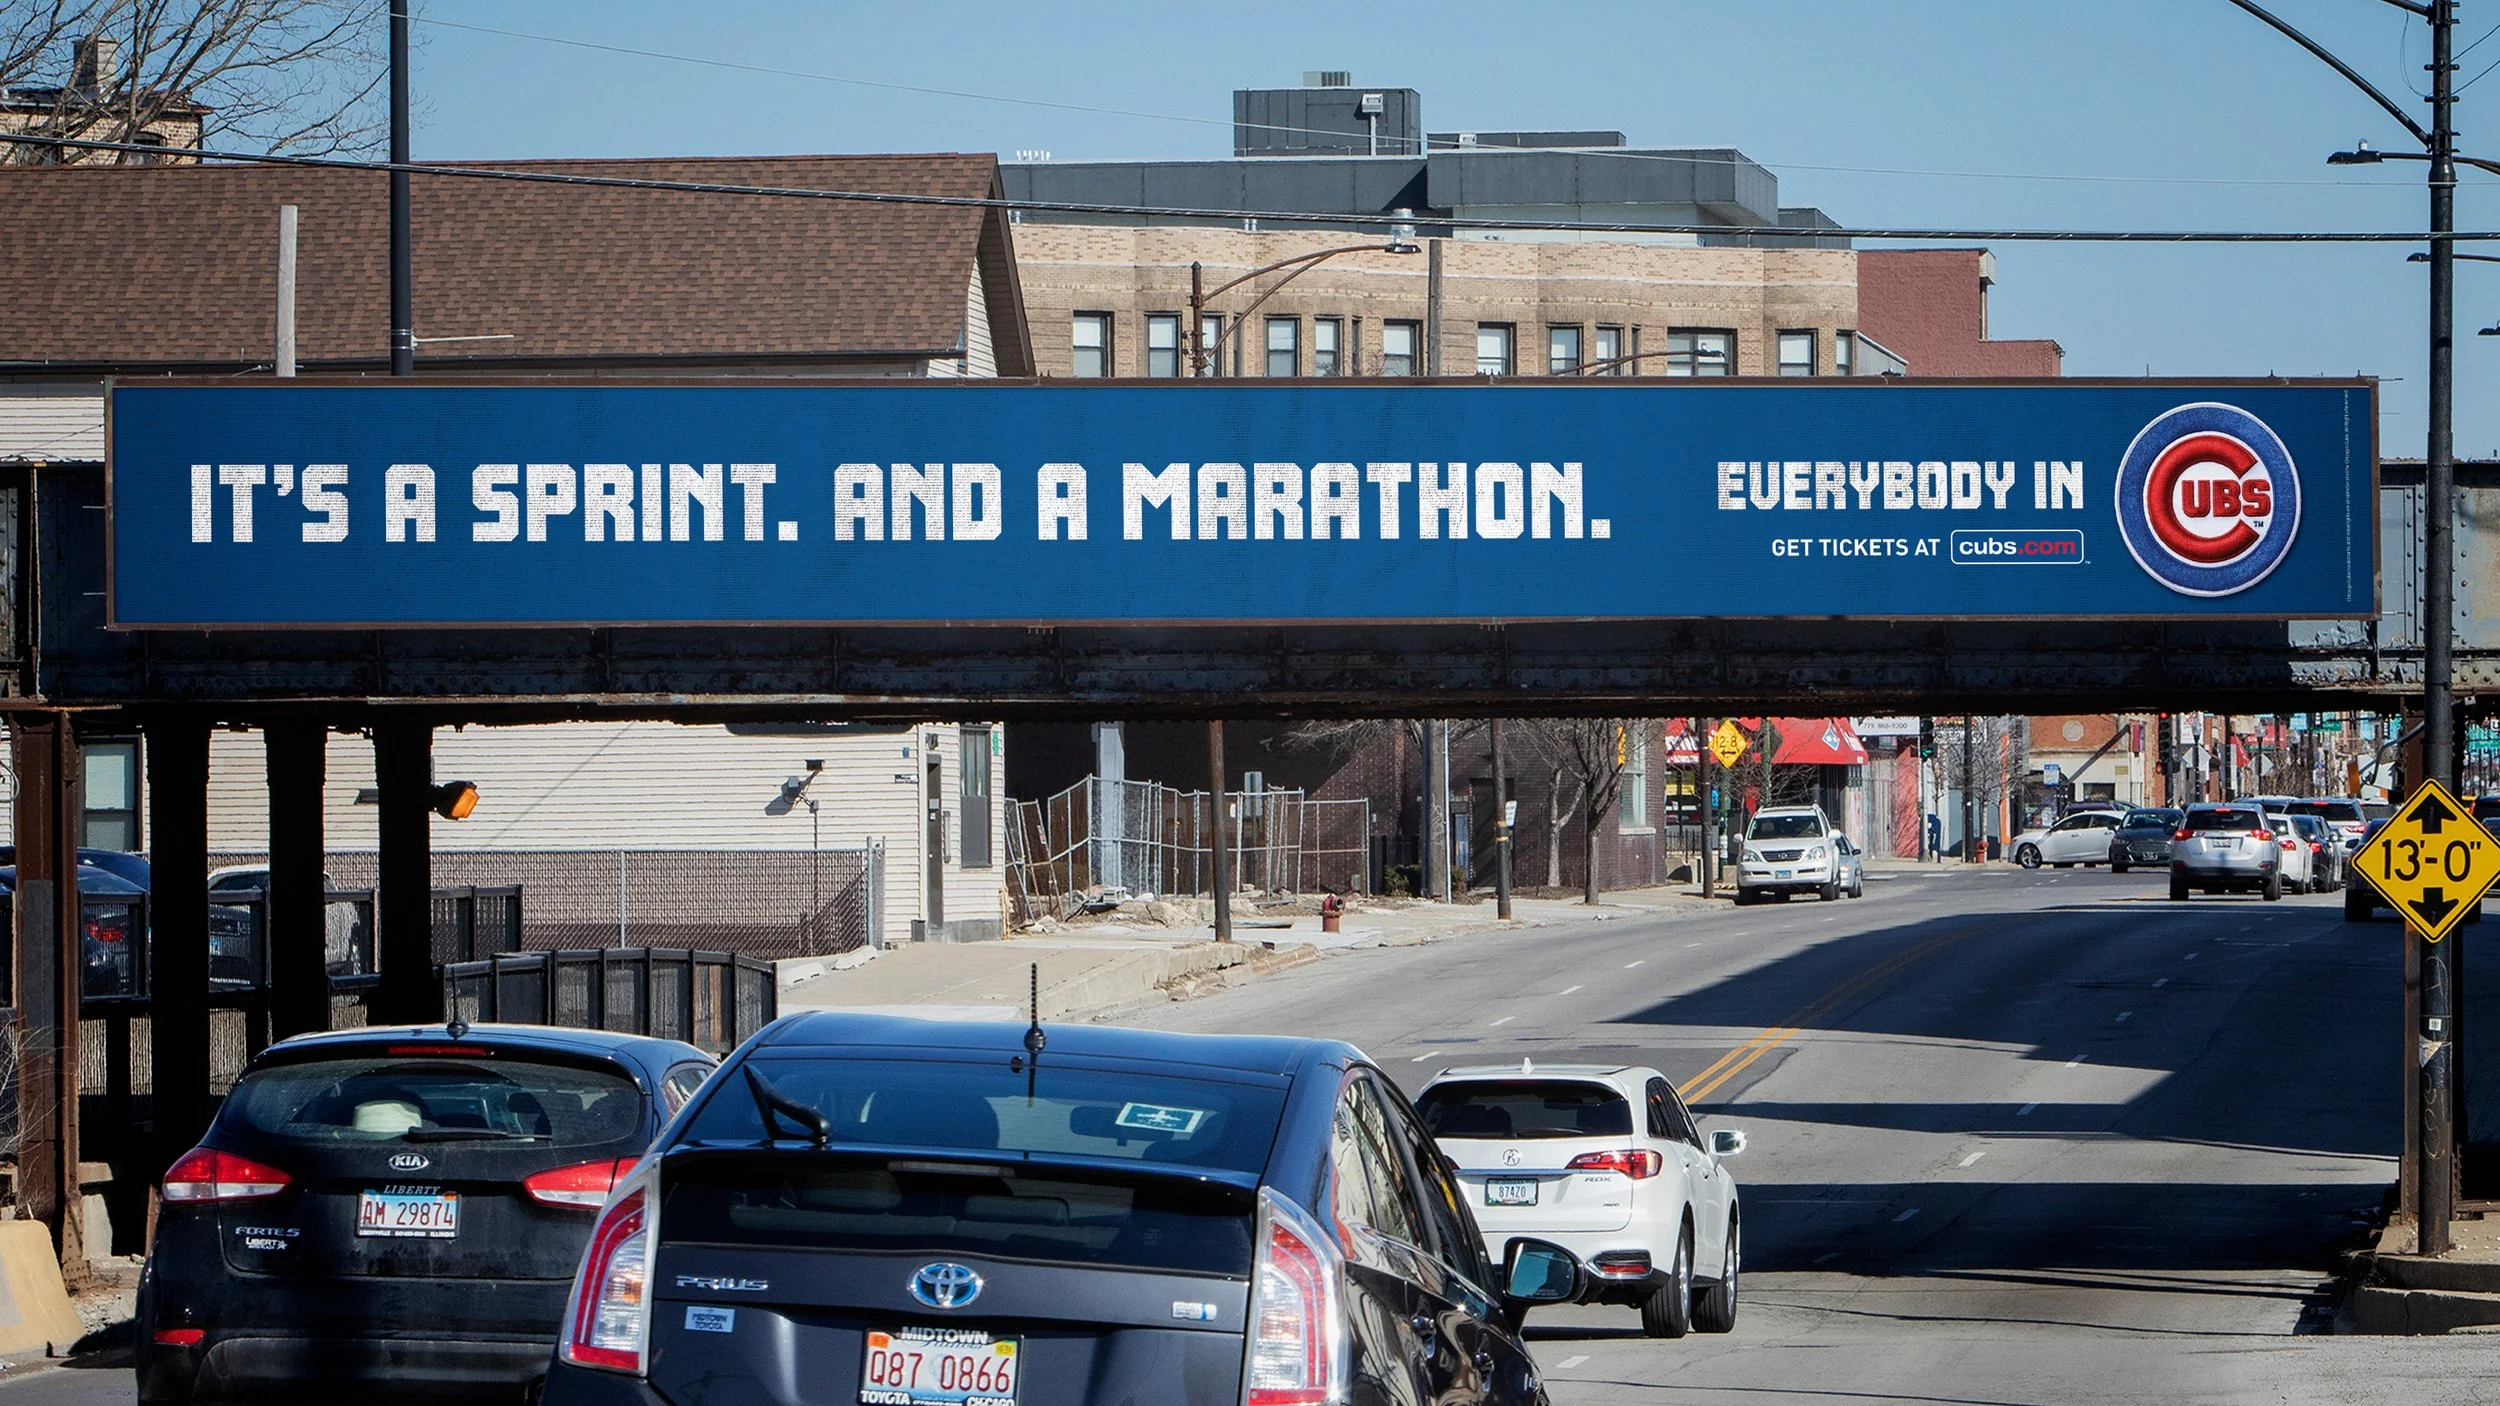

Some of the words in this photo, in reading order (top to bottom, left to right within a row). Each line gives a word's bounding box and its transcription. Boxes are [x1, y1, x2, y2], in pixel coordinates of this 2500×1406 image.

[1718, 461, 2015, 510] EVERYBODY
[2035, 461, 2084, 509] IN
[192, 464, 348, 542] IT'S
[386, 465, 436, 542] A
[472, 464, 798, 542] SPRINT.
[834, 463, 1002, 541] AND
[1037, 463, 1088, 541] A
[1122, 462, 1611, 540] MARATHON.
[1772, 539, 1813, 557] GET
[1818, 538, 1909, 557] TICKETS
[1915, 538, 1941, 556] AT
[1959, 537, 2076, 555] cubs.com
[394, 1155, 422, 1167] KIA
[383, 1184, 441, 1195] LIBERTY
[362, 1200, 386, 1225] AM
[396, 1201, 453, 1226] 29874
[676, 1275, 769, 1292] PRIUS
[900, 1326, 989, 1345] MIDTOWN
[870, 1350, 923, 1389] Q87
[940, 1355, 1011, 1393] 0866
